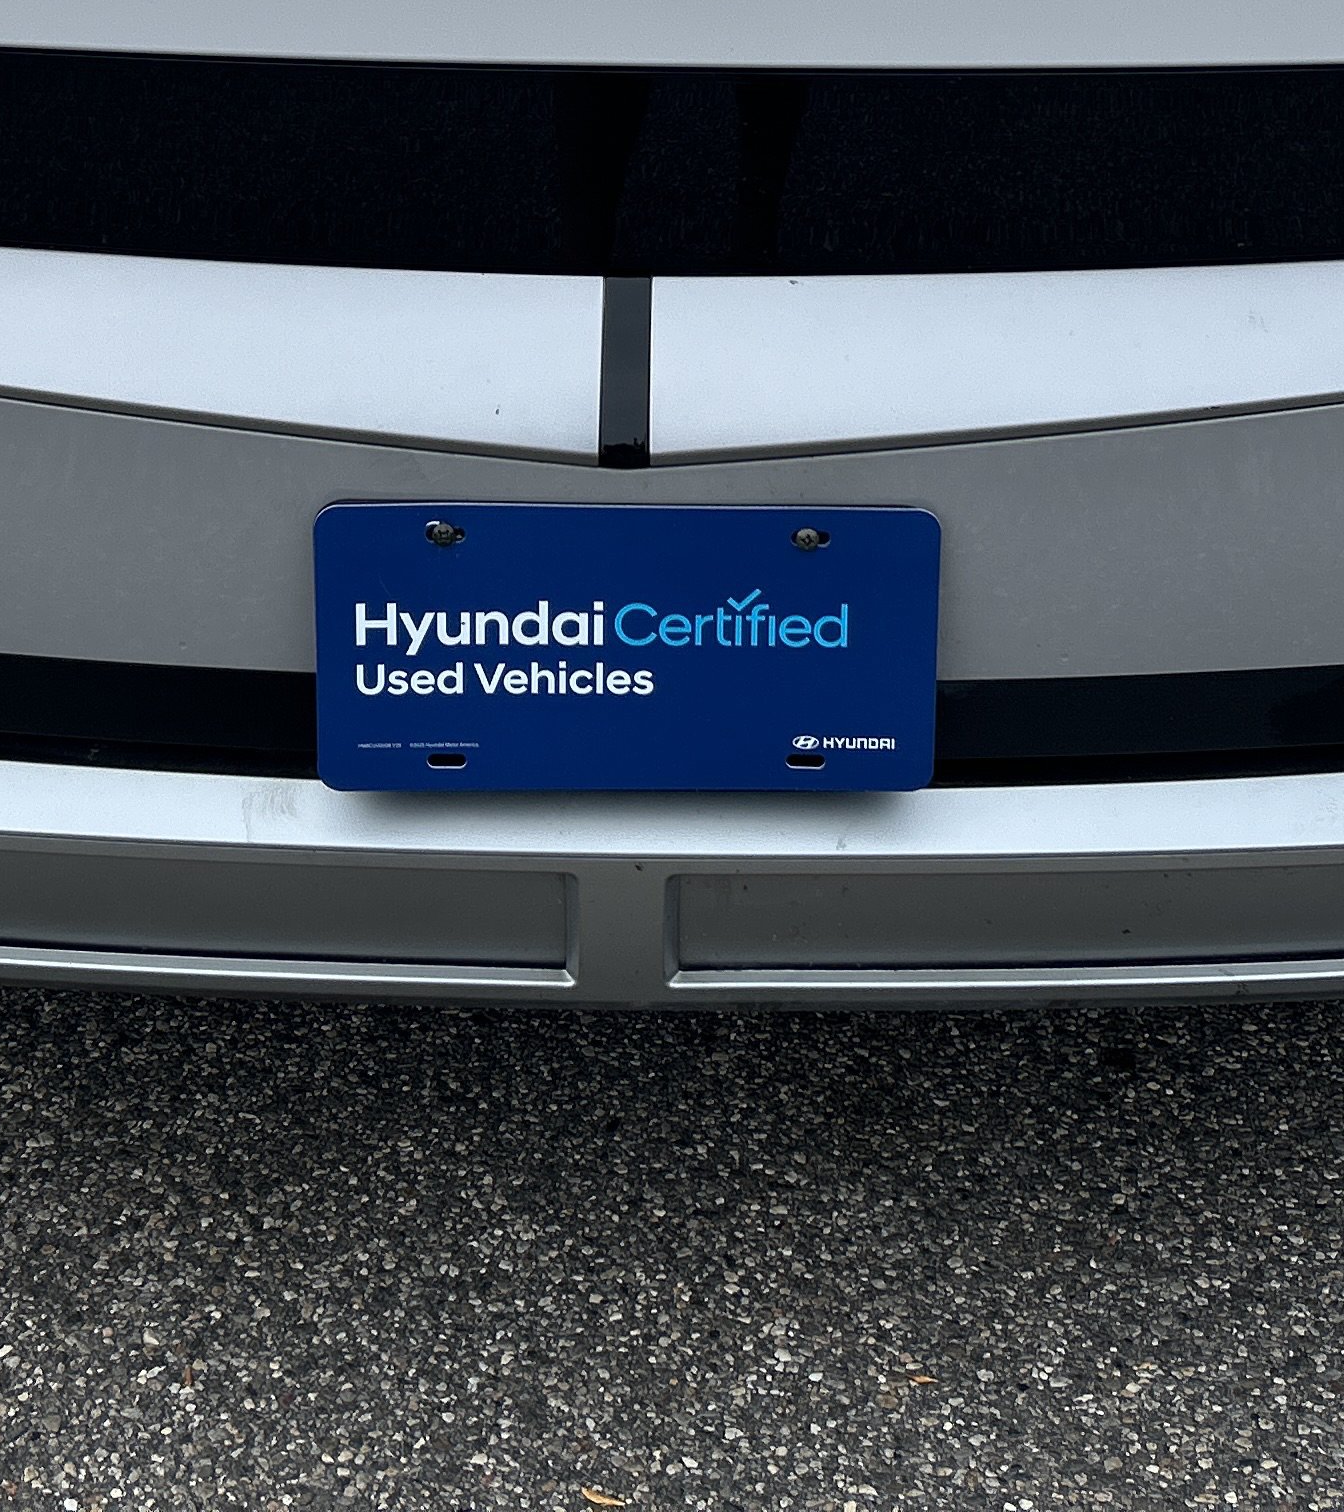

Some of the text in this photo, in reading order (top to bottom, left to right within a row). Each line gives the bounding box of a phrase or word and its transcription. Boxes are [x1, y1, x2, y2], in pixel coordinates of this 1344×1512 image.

[356, 589, 849, 656] Hyundai Certified
[356, 660, 655, 696] Used Vehicles
[823, 736, 896, 750] HYUNDAI
